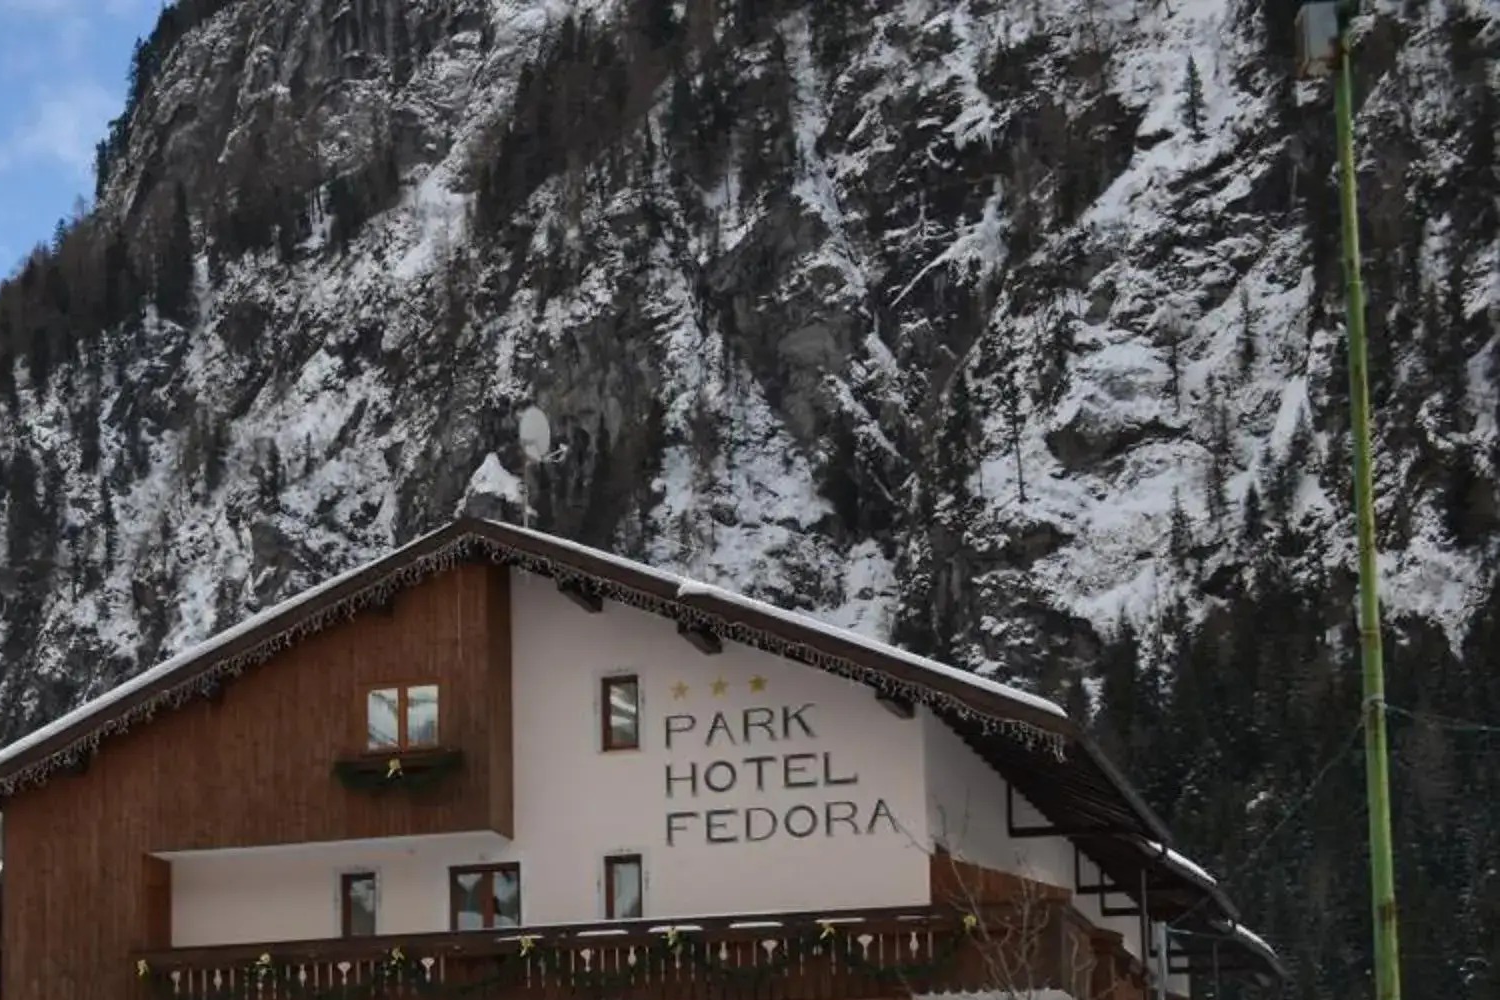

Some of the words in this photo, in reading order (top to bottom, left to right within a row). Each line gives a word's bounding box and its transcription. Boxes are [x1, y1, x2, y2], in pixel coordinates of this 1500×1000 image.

[664, 703, 817, 749] PARK
[665, 752, 858, 798] HOTEL
[666, 798, 900, 847] FEDORA
